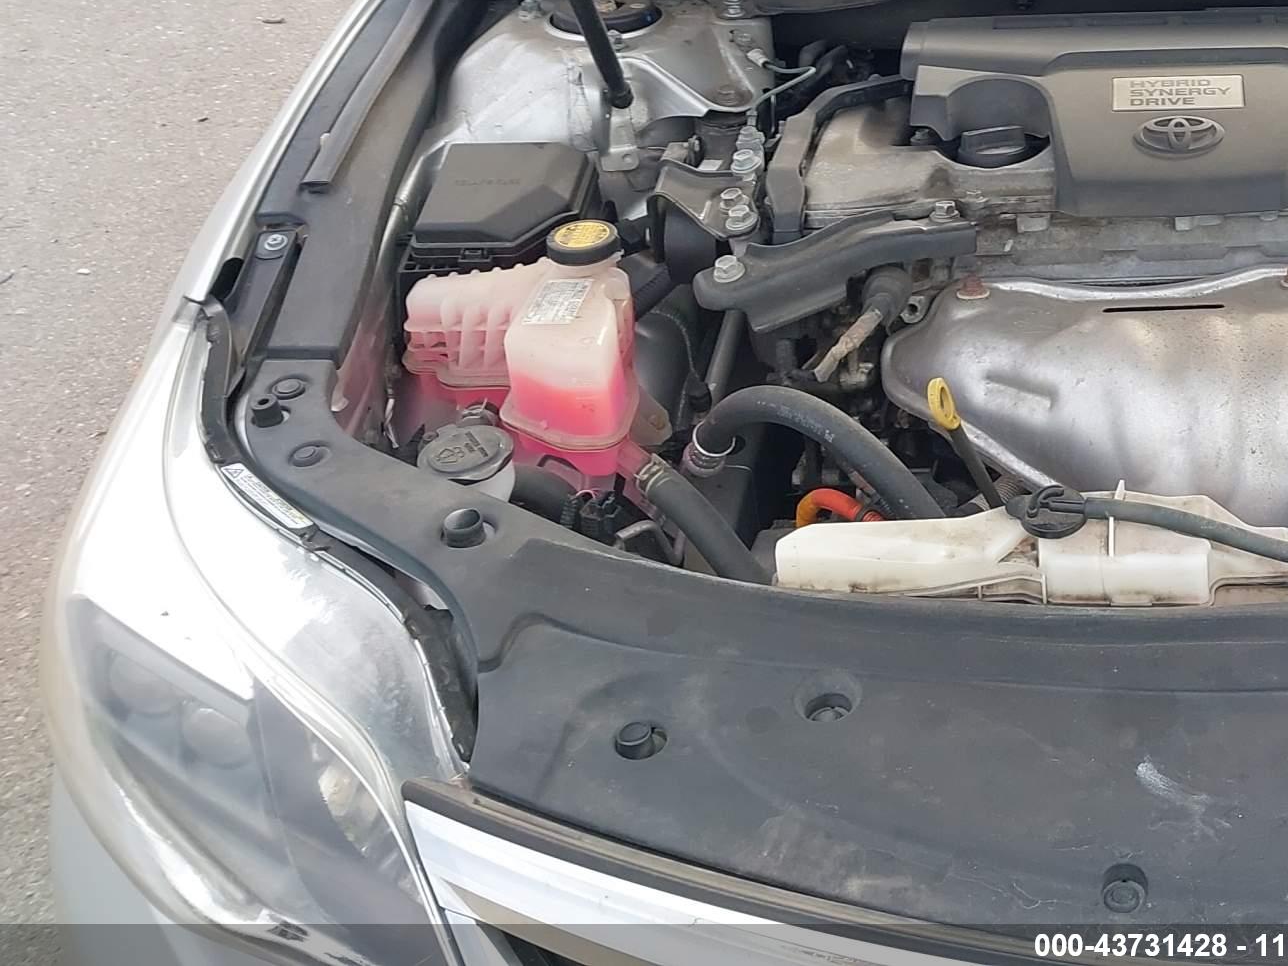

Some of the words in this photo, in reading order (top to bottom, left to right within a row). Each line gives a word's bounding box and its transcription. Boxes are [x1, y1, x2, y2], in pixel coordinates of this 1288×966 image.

[1130, 78, 1211, 88] HYBRID
[1130, 87, 1231, 97] SYNERGY
[1130, 97, 1196, 106] DRIVE
